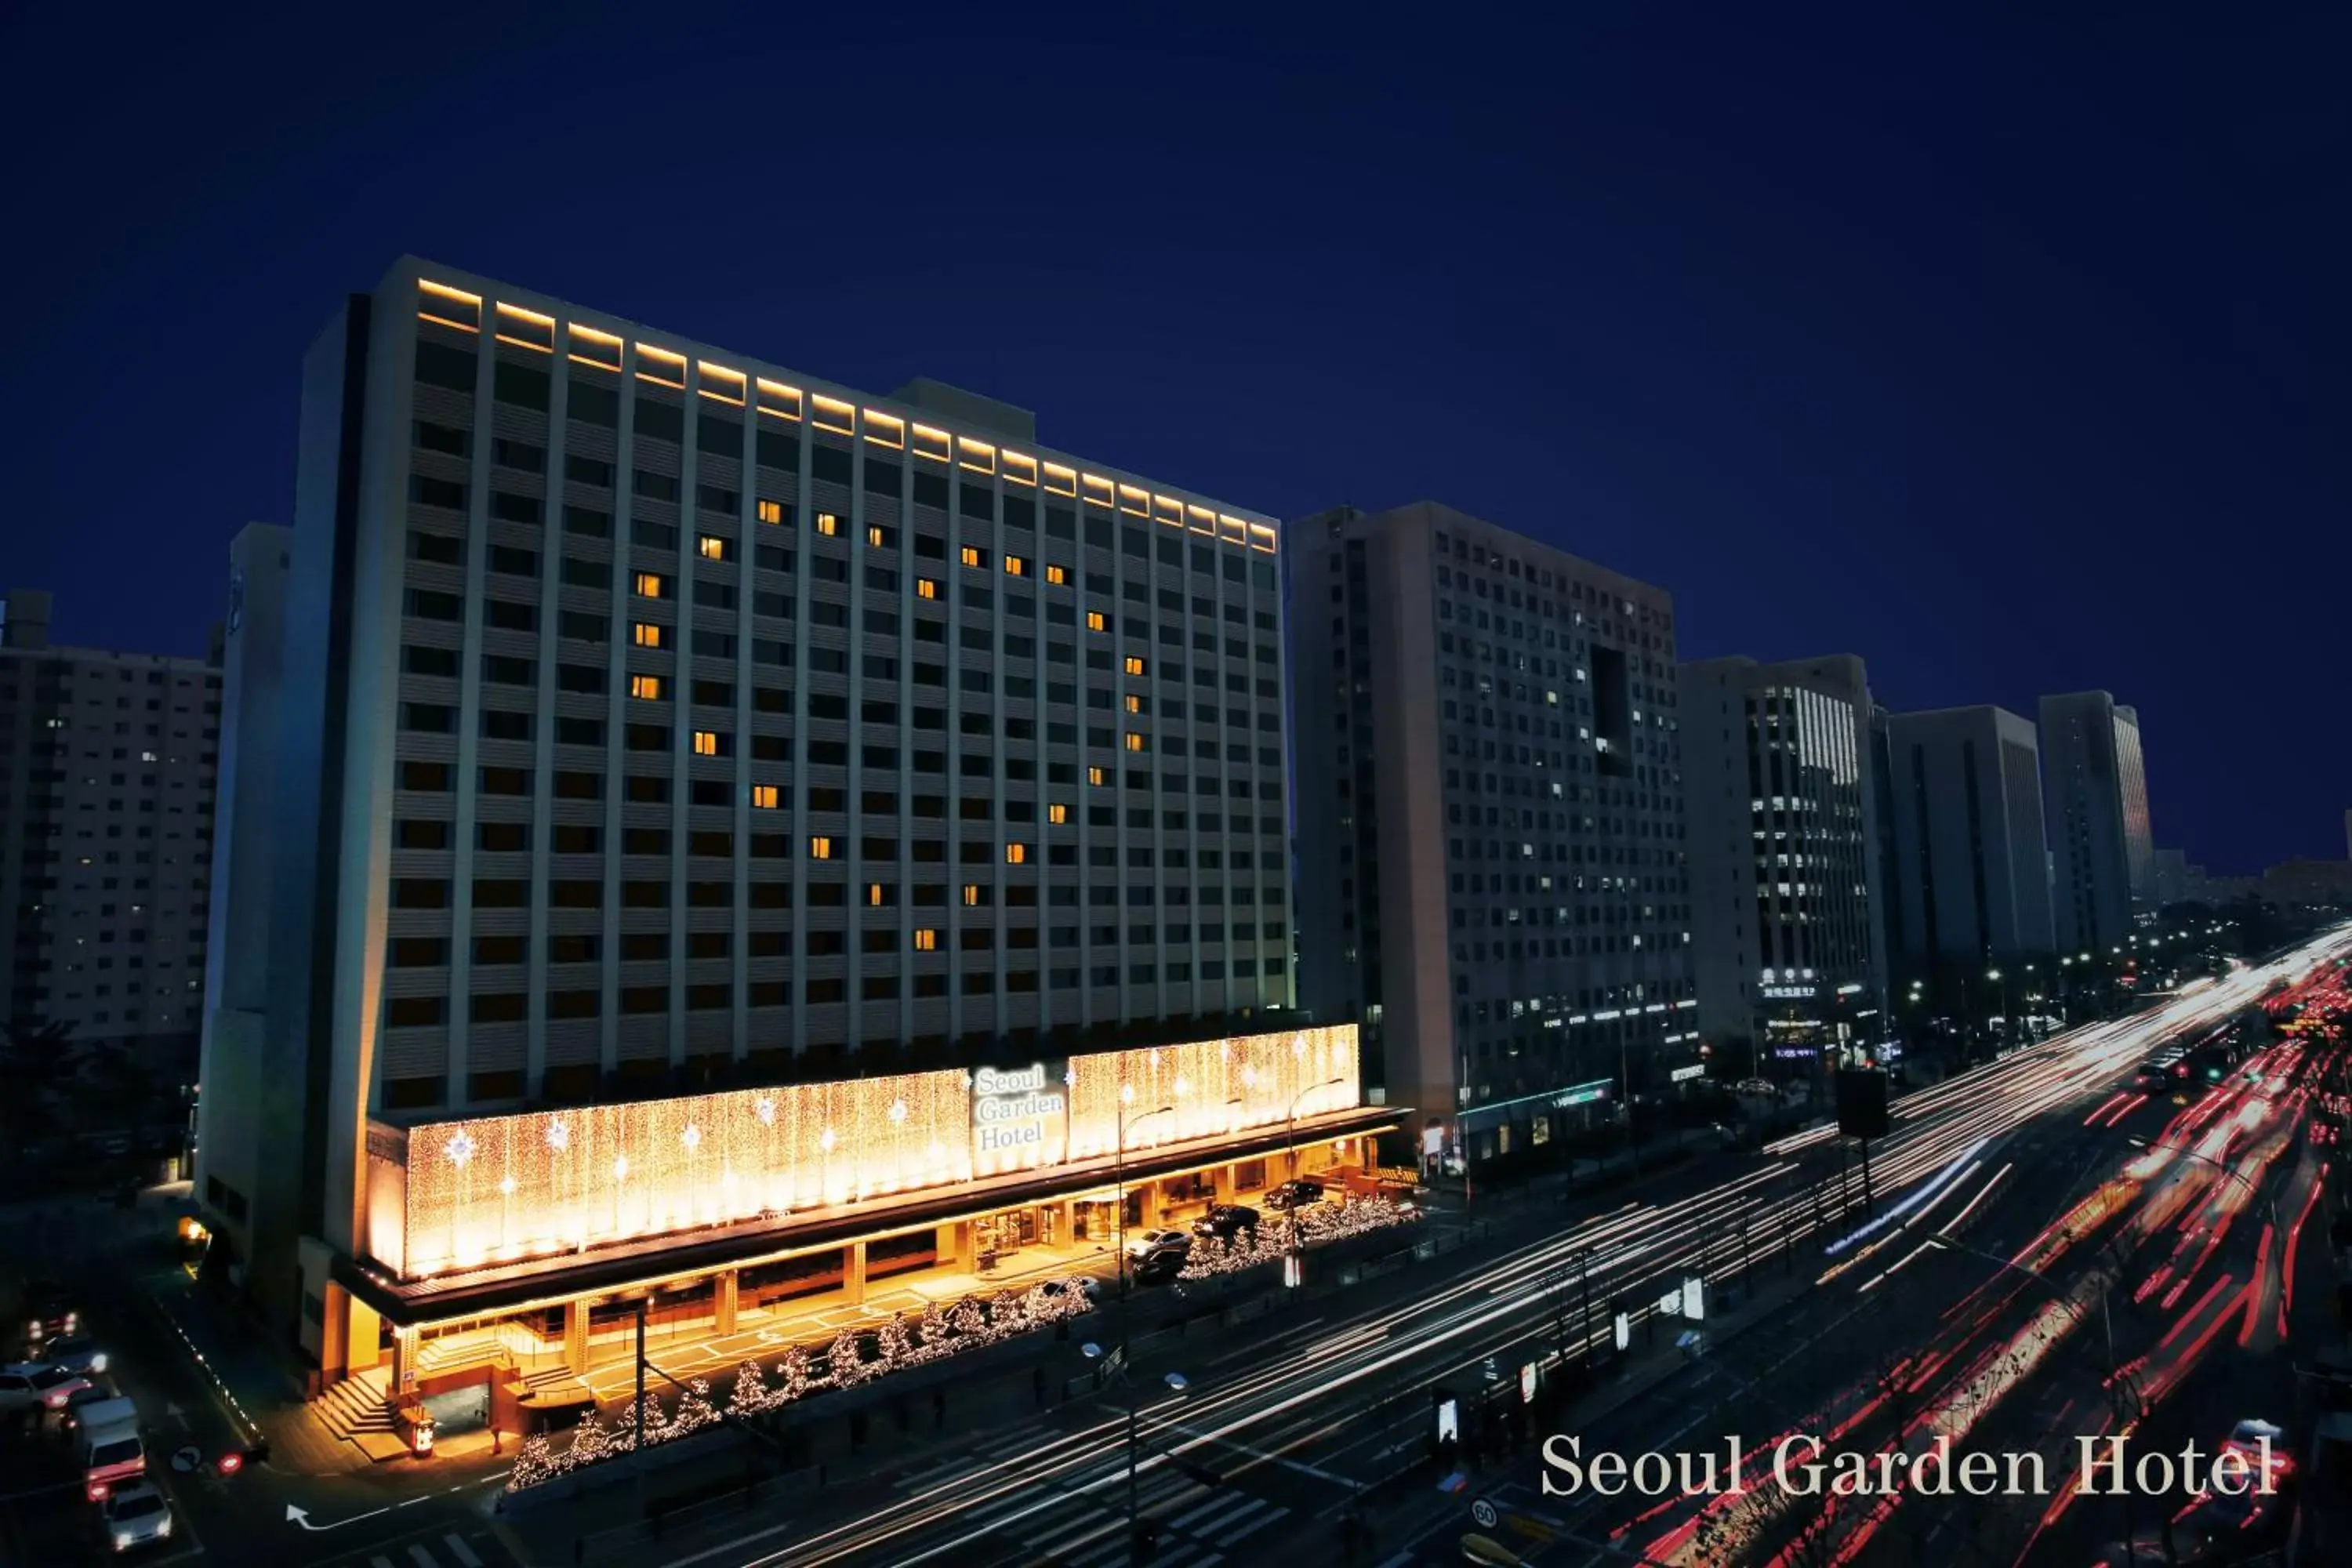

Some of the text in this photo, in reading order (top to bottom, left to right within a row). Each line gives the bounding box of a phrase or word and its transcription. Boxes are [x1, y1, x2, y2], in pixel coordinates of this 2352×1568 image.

[978, 1065, 1043, 1093] Seoul
[980, 1094, 1062, 1121] Garden
[981, 1121, 1042, 1151] Hotel
[1475, 1504, 1494, 1523] 60
